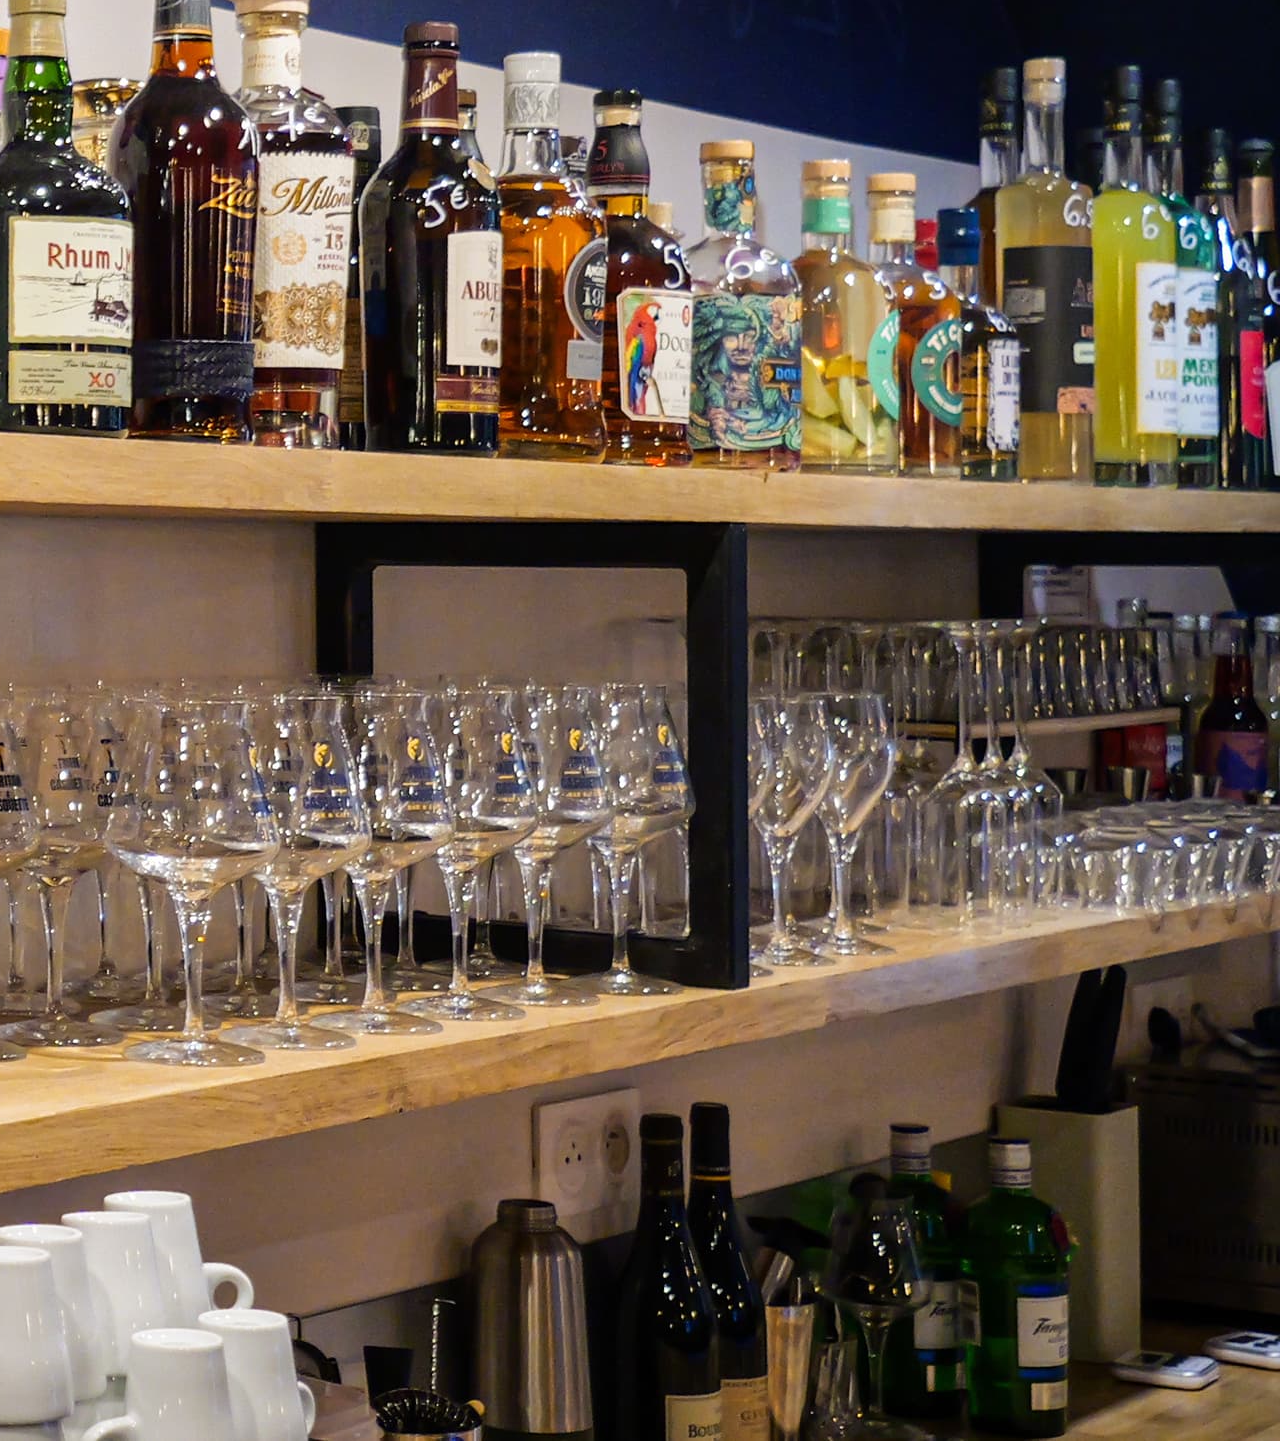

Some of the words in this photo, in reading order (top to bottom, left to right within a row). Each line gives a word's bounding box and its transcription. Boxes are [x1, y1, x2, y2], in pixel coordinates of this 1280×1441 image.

[325, 233, 344, 252] 15
[47, 242, 110, 271] Rhum
[461, 281, 501, 303] ABUE
